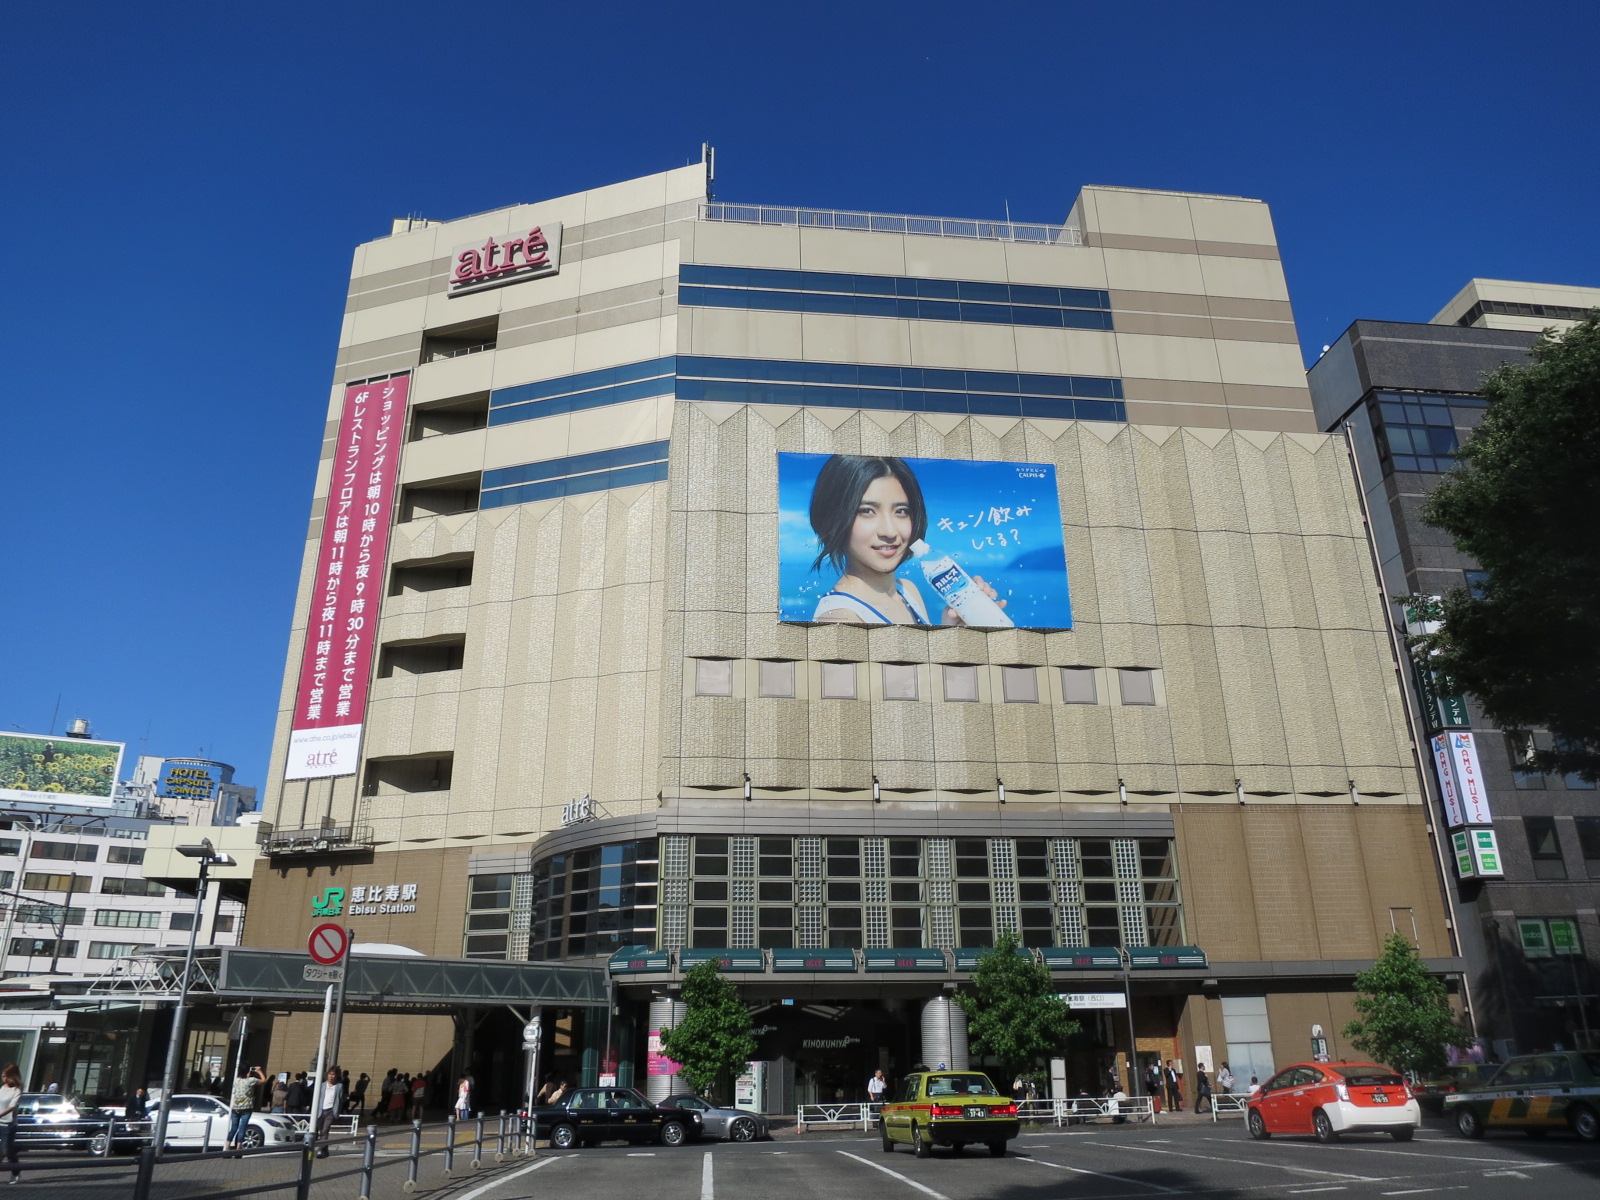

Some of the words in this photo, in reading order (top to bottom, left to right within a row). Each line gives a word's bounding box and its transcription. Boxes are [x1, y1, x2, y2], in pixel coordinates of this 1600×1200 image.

[455, 226, 549, 279] atré
[937, 505, 1033, 533] キュン飲み
[306, 748, 338, 767] atré
[164, 776, 215, 789] CAPSULE
[170, 767, 210, 779] HOTEL
[173, 785, 211, 797] SINGLE
[1439, 751, 1449, 776] AMG
[1445, 780, 1459, 824] MUSIC
[1461, 749, 1473, 775] AMG
[1467, 778, 1483, 822] MUSIC
[560, 794, 590, 824] atré
[312, 887, 345, 908] JR
[350, 883, 417, 903] 恵比寿駅
[349, 905, 377, 915] Ebisu
[380, 903, 416, 913] Station
[803, 1039, 846, 1048] KINOKUNIYA
